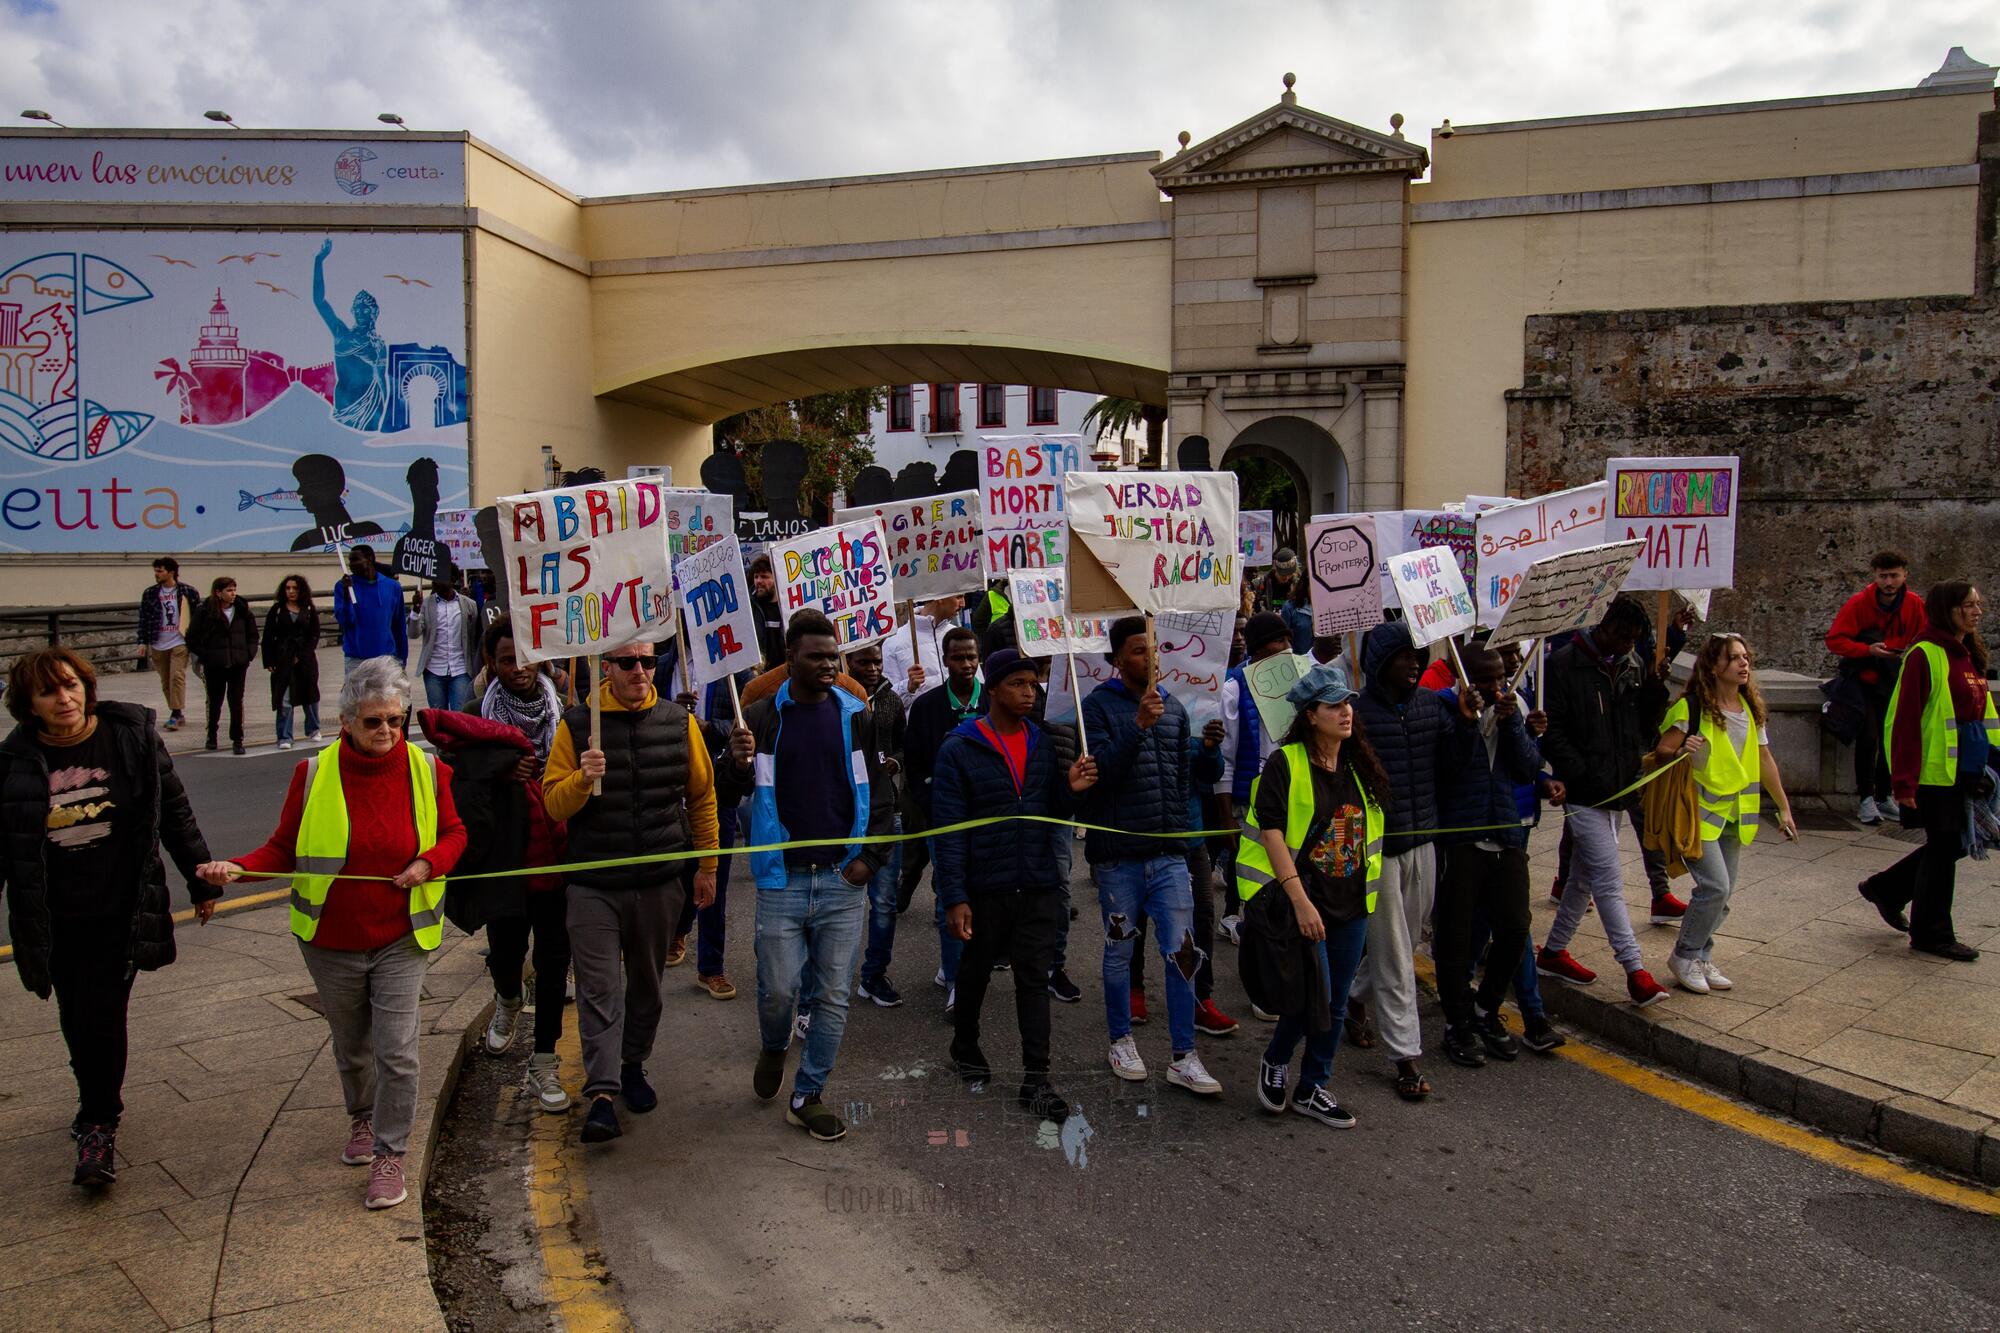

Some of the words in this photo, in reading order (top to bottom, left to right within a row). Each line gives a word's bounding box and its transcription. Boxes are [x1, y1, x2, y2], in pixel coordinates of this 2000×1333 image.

[5, 162, 83, 184] unen
[92, 150, 141, 185] las
[146, 156, 298, 186] emociones
[986, 443, 1078, 479] BASTA
[513, 482, 660, 542] ABRID
[989, 484, 1064, 515] MORTI
[1105, 482, 1203, 512] VERDAD
[1617, 471, 1730, 516] RACISMO
[320, 522, 353, 545] LUC
[403, 536, 437, 558] ROGER
[987, 530, 1064, 573] MARE
[1626, 523, 1711, 569] MATA
[518, 545, 591, 597] LAS
[787, 564, 888, 610] HUMANOS
[685, 572, 739, 628] TODO
[822, 592, 847, 615] EN
[849, 584, 878, 608] LAS
[705, 623, 743, 665] MAL
[1256, 662, 1295, 694] STO
